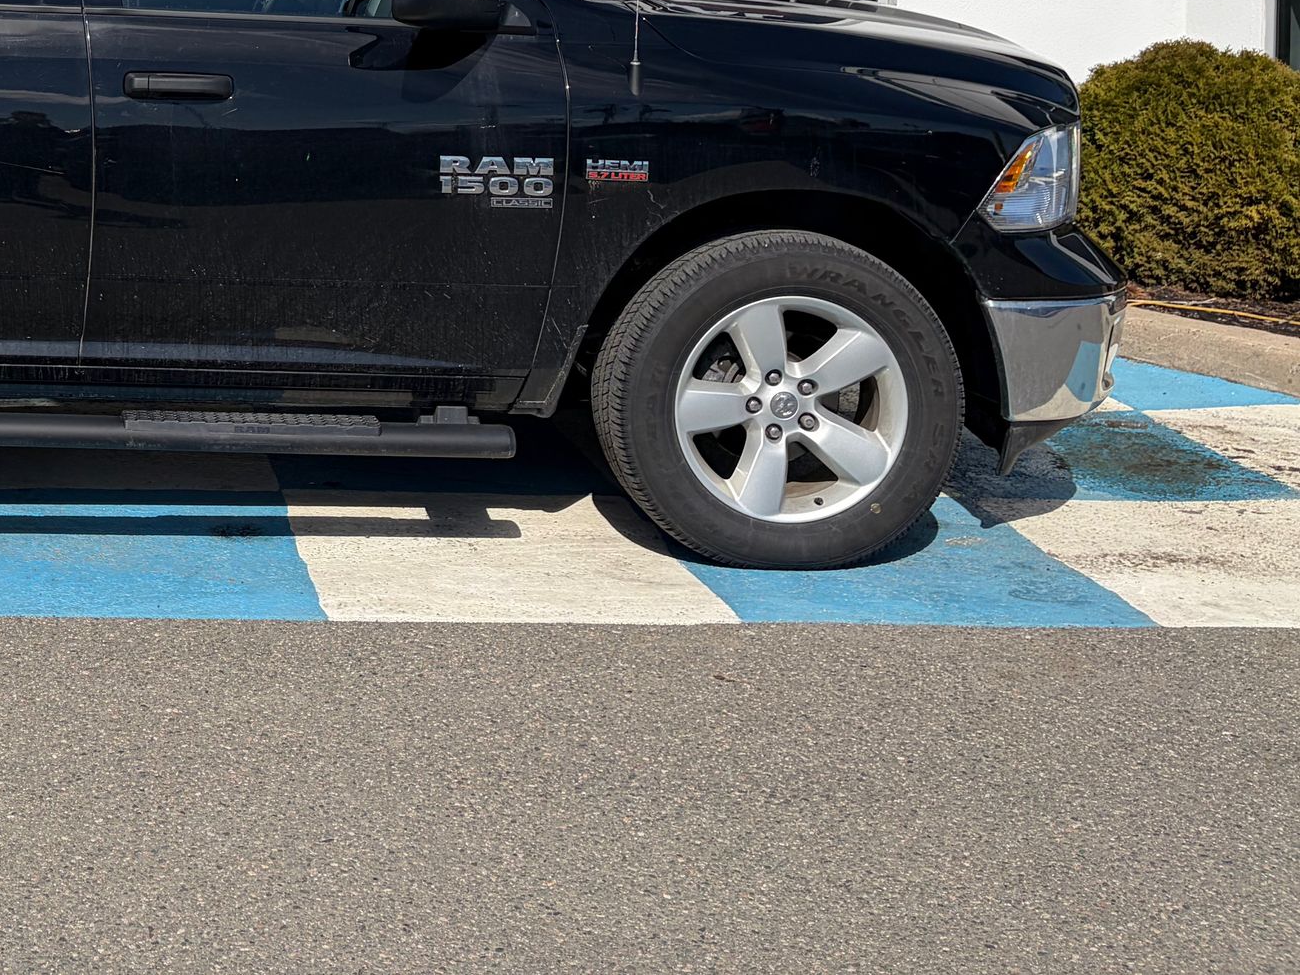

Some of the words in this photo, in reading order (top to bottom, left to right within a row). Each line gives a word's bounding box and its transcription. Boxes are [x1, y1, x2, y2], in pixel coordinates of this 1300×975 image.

[439, 155, 554, 175] RAM
[586, 158, 649, 172] HEMI
[588, 171, 609, 179] 5.7
[611, 172, 647, 180] LITER
[439, 176, 554, 196] 1500
[493, 199, 552, 207] CLASSIC
[786, 262, 946, 398] WRANGLER
